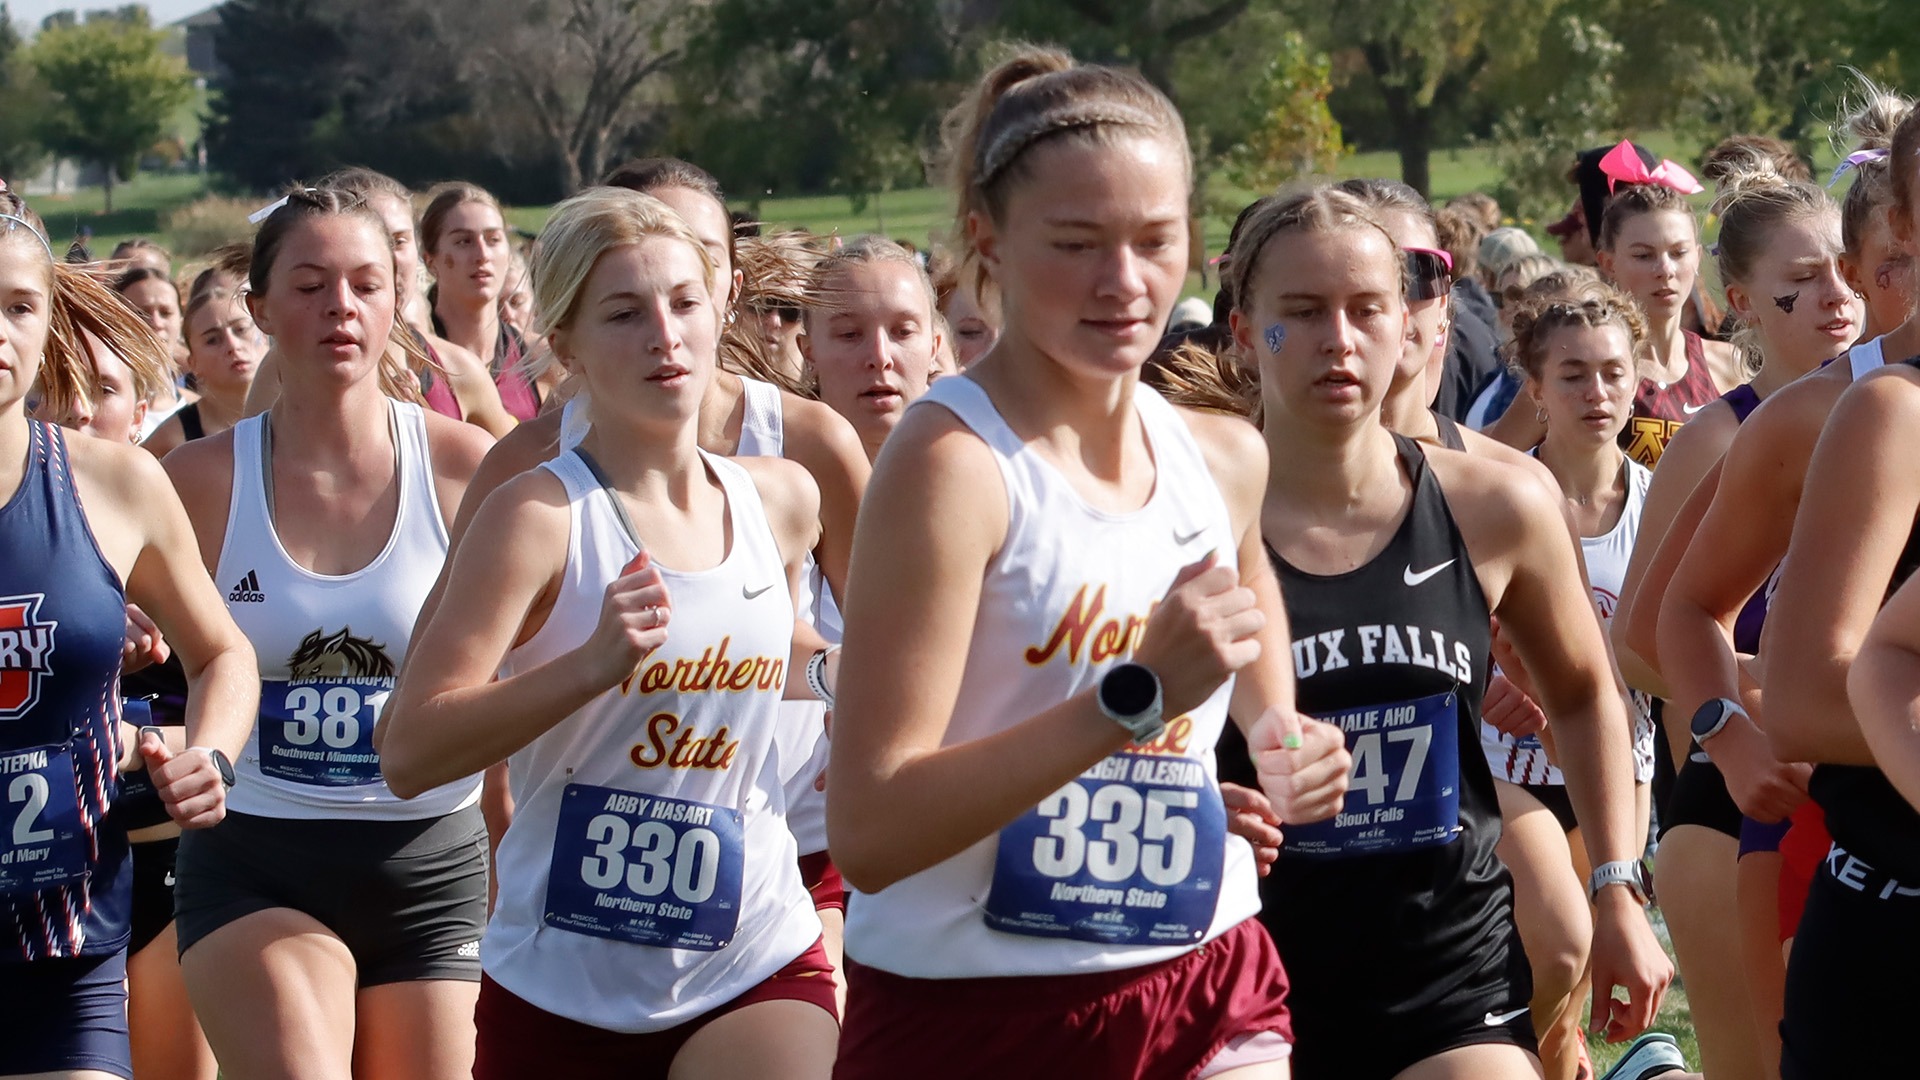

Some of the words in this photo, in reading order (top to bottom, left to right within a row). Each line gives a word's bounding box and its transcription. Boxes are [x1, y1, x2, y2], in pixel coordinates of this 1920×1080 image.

[229, 590, 265, 602] adidas
[1357, 624, 1472, 684] FALLS
[283, 686, 393, 749] 381
[1382, 705, 1416, 728] AHO
[271, 744, 325, 761] Southwest
[326, 750, 380, 764] Minnesota
[630, 713, 740, 770] State
[0, 750, 48, 774] TEPKA
[8, 773, 54, 845] 2
[604, 793, 651, 816] ABBY
[651, 800, 714, 826] HASART
[1335, 813, 1371, 828] Sioux
[1373, 807, 1405, 825] Falls
[1032, 781, 1199, 886] 335
[2, 850, 14, 864] of
[17, 847, 50, 863] Mary
[580, 814, 721, 903] 330
[594, 892, 656, 915] Northern
[657, 902, 693, 920] State
[1051, 882, 1124, 906] Northern
[1125, 887, 1168, 908] State
